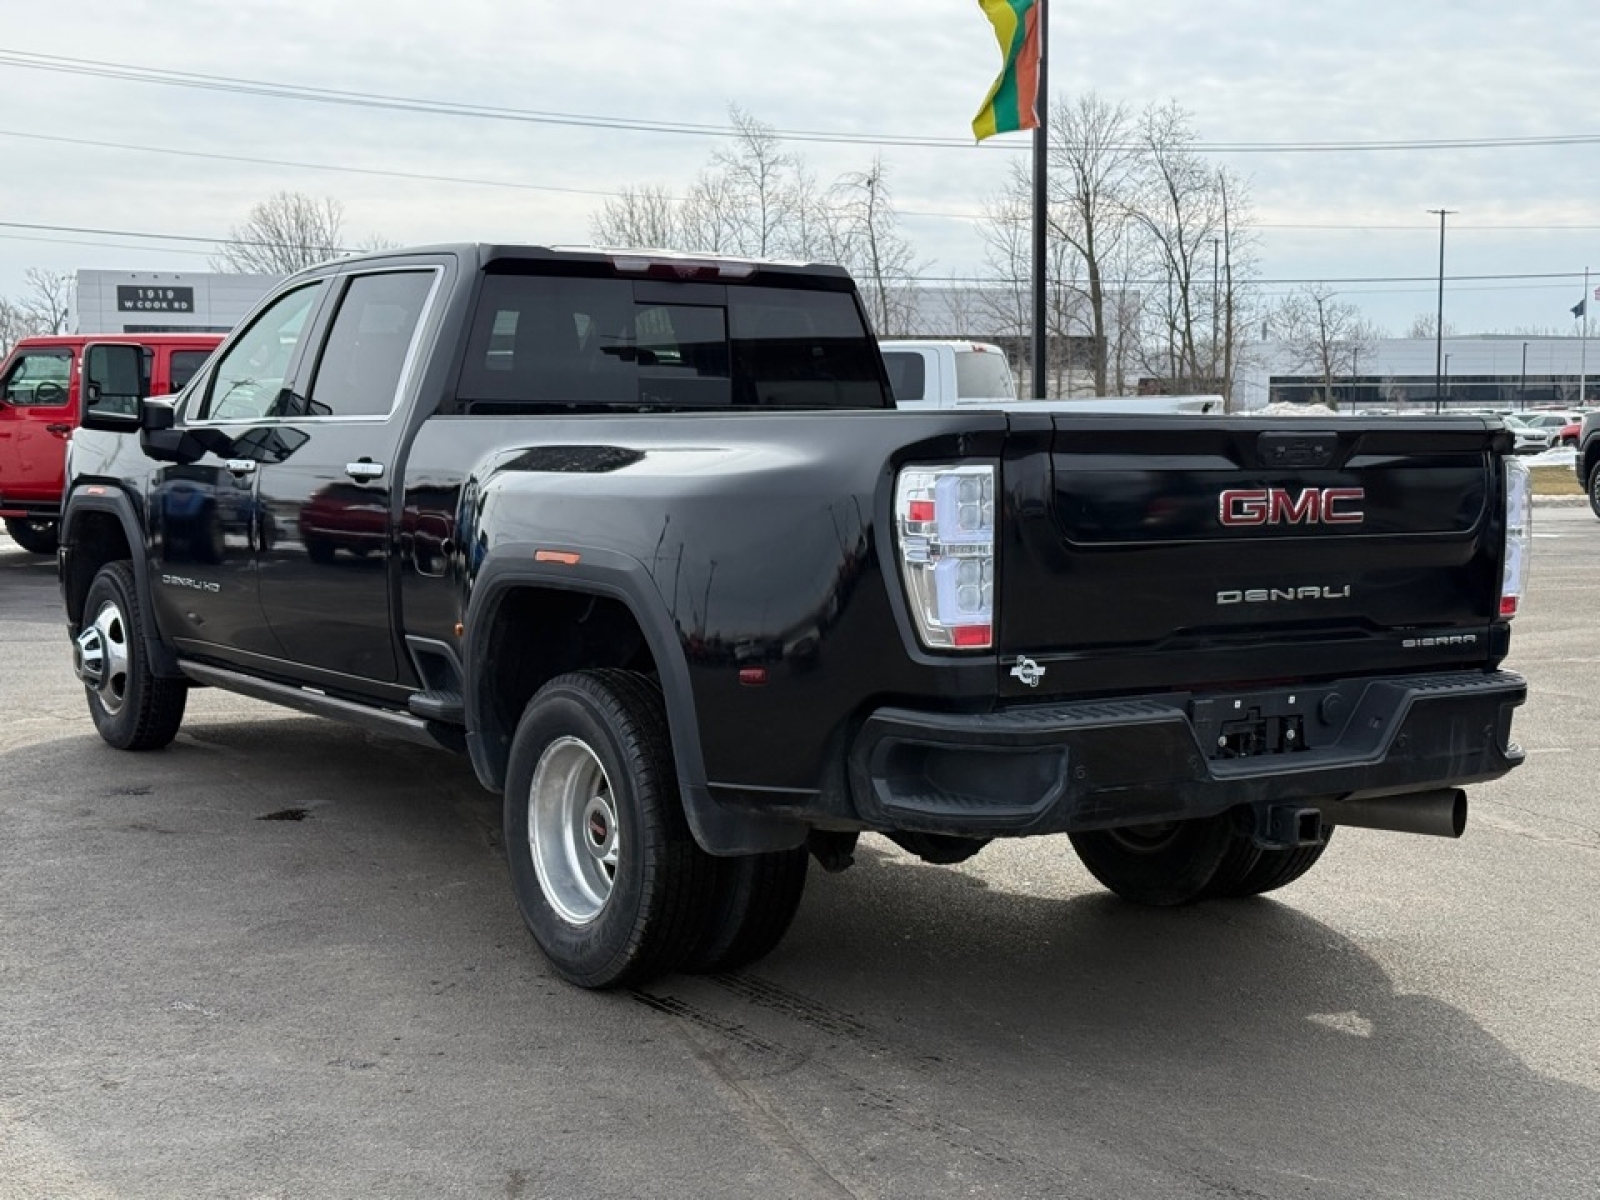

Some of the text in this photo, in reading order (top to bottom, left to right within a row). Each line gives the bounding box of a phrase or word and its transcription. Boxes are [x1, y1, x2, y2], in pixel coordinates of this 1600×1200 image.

[137, 289, 174, 299] 1919
[124, 301, 188, 309] W COOK RD
[1219, 488, 1365, 526] GMC
[162, 574, 202, 590] DENALI
[1216, 584, 1351, 605] DENALI
[1402, 634, 1477, 648] SIERRA
